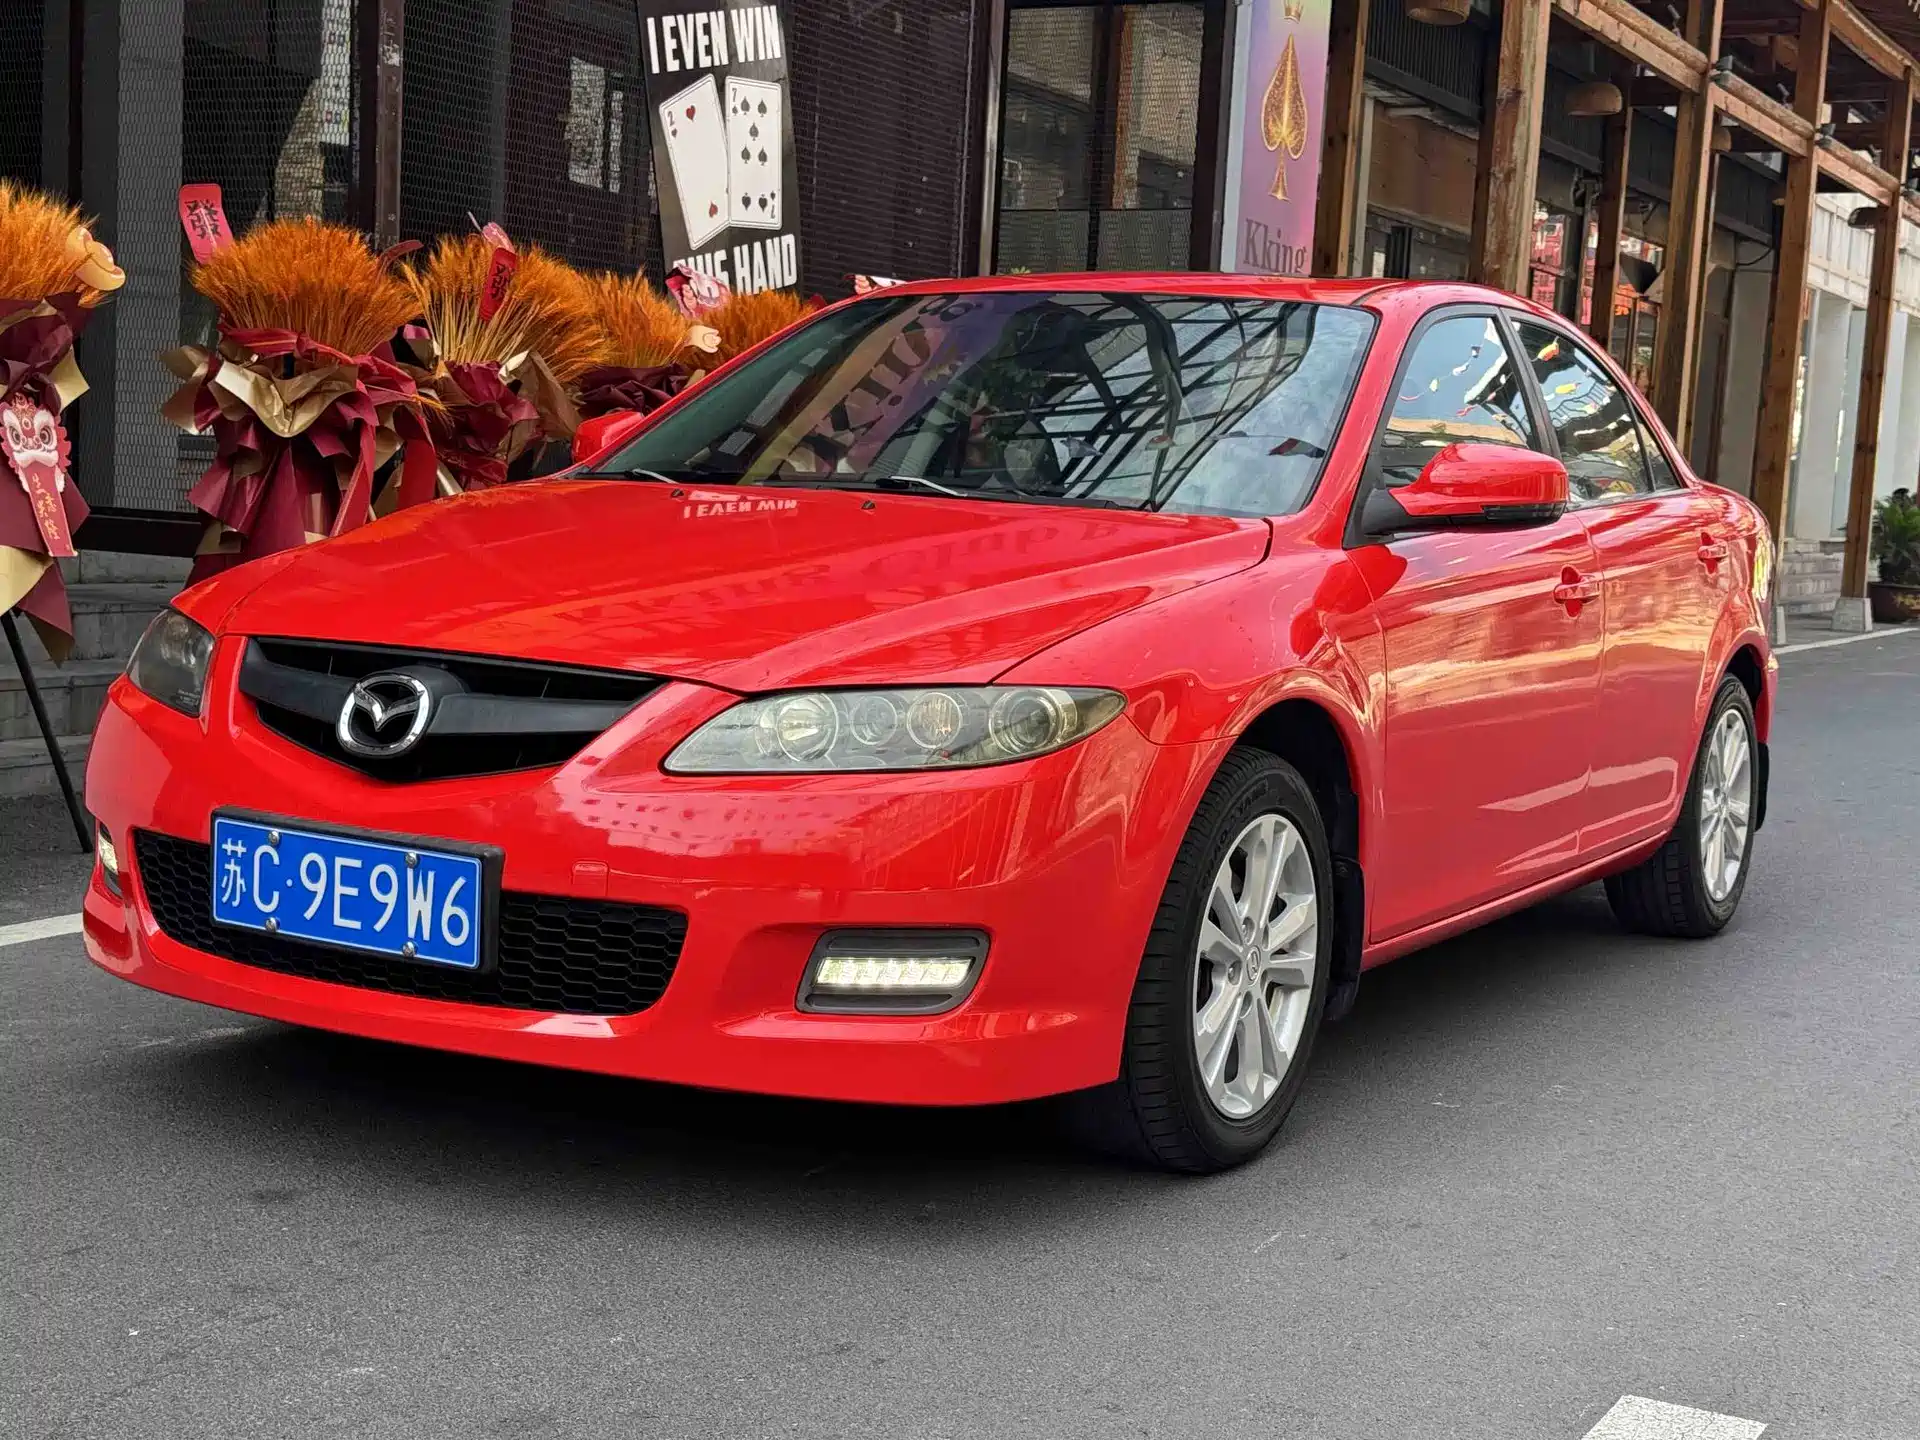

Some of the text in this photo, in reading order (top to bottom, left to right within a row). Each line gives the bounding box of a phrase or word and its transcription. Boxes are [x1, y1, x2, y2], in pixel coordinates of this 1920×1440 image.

[646, 5, 781, 74] I EVEN WIN
[672, 233, 798, 301] HIS HAND
[220, 837, 471, 947] 苏C·9E9W6
